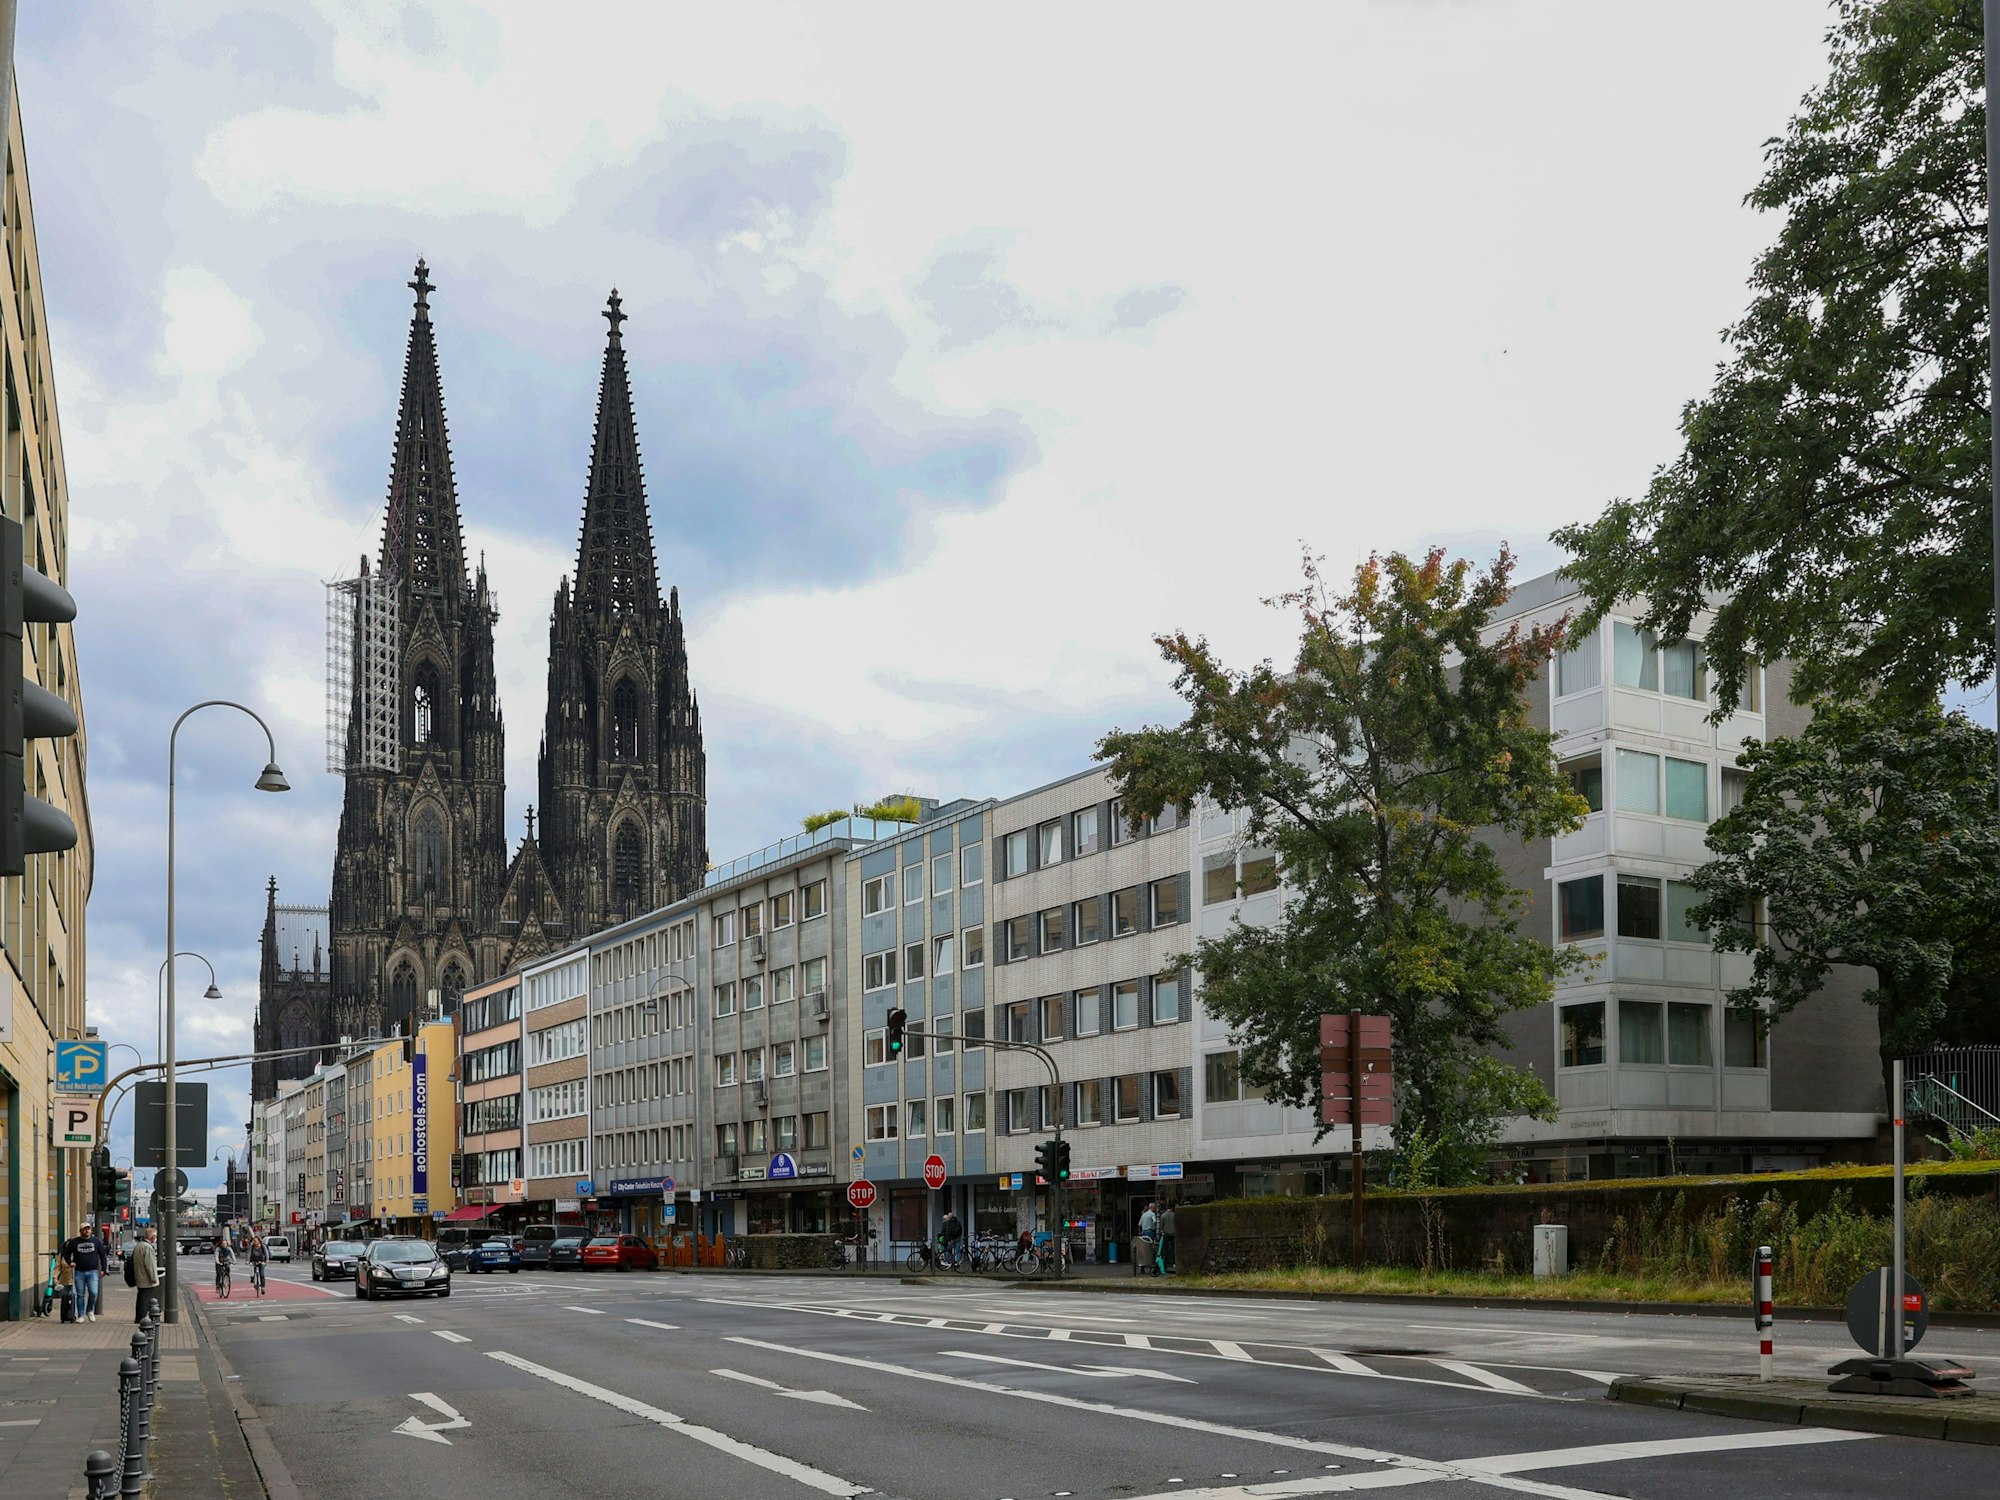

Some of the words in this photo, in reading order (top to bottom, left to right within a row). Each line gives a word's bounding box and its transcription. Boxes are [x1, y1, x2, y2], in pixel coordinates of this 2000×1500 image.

[75, 1055, 99, 1079] P
[69, 1110, 88, 1131] P
[413, 1073, 426, 1173] aohostels.com
[925, 1164, 944, 1178] STOP
[850, 1188, 873, 1199] STOP
